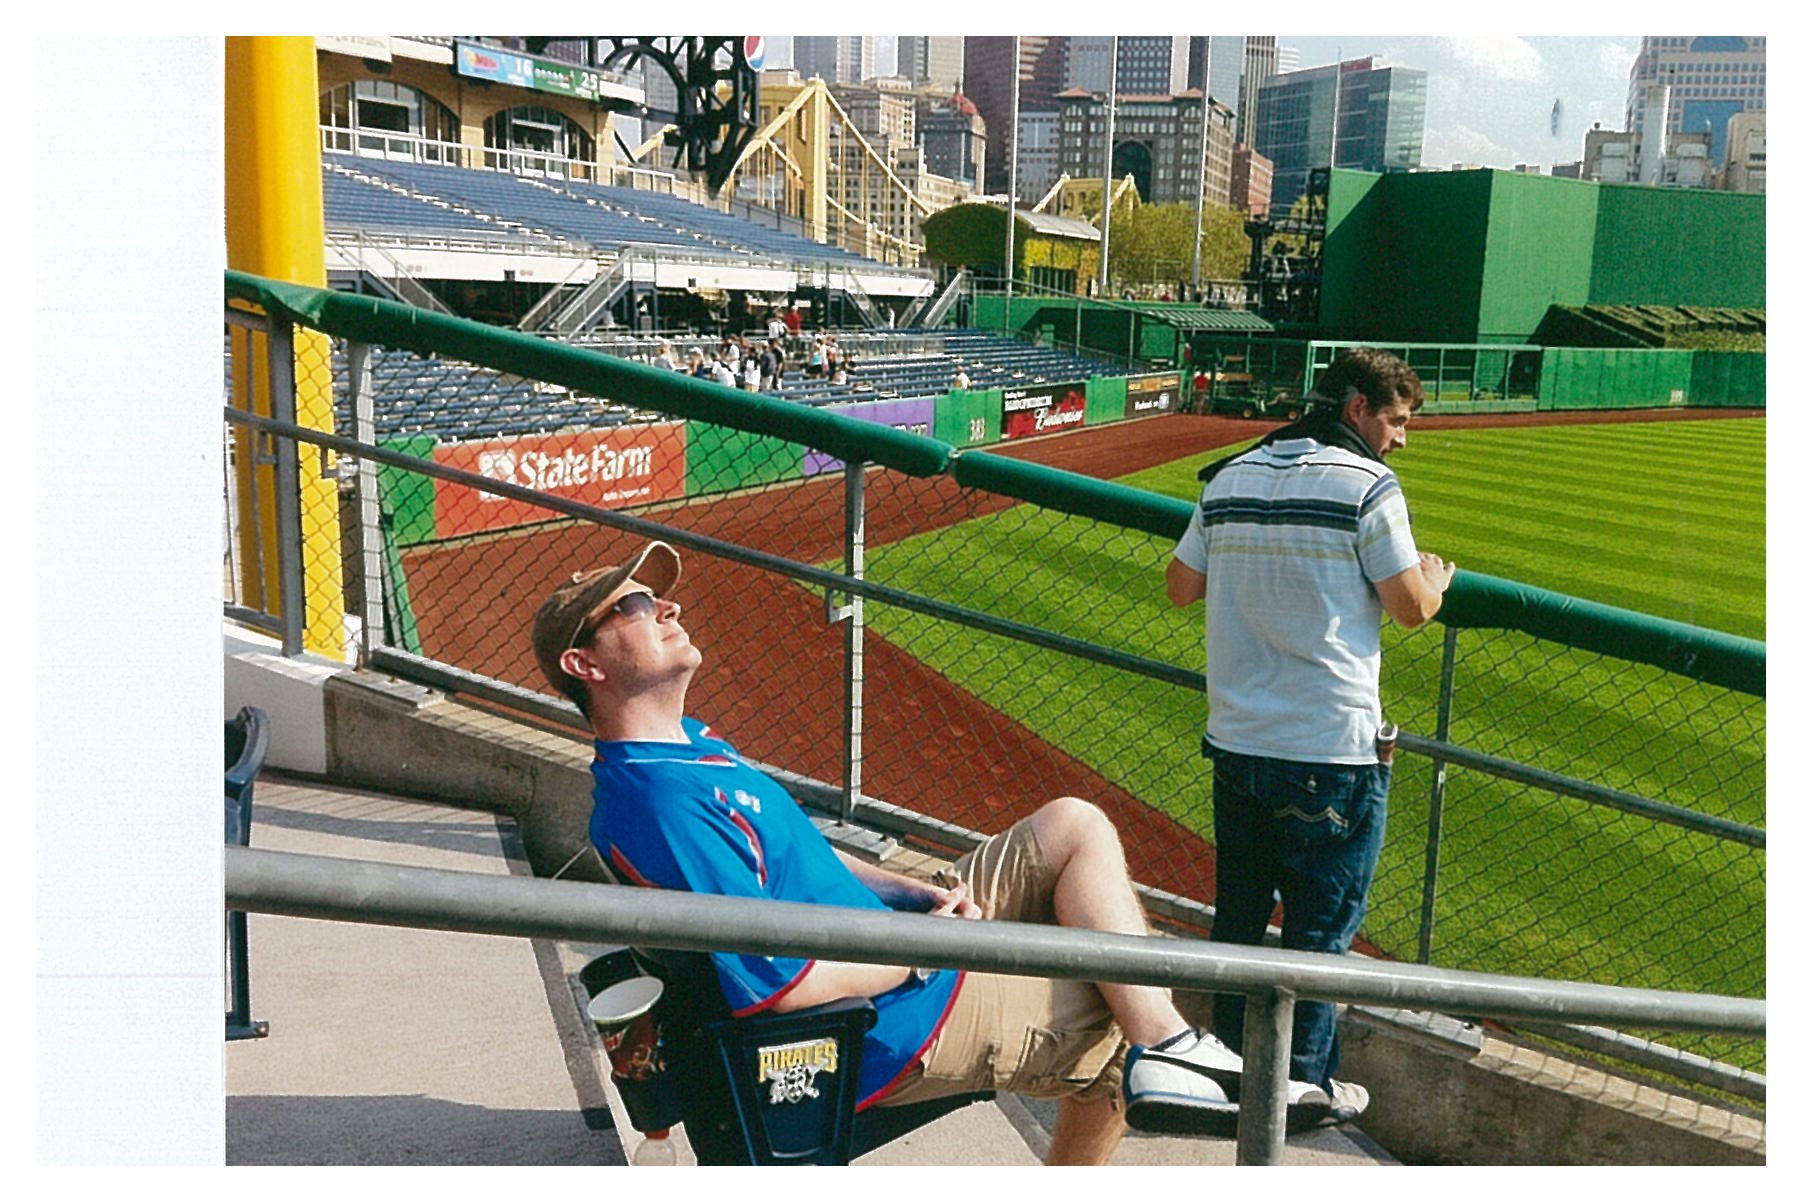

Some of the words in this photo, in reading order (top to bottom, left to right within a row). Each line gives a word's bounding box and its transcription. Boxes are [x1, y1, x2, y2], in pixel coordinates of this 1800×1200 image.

[580, 72, 598, 91] 25
[521, 448, 588, 490] State
[591, 444, 654, 482] Farm
[758, 1038, 838, 1083] PIRATES
